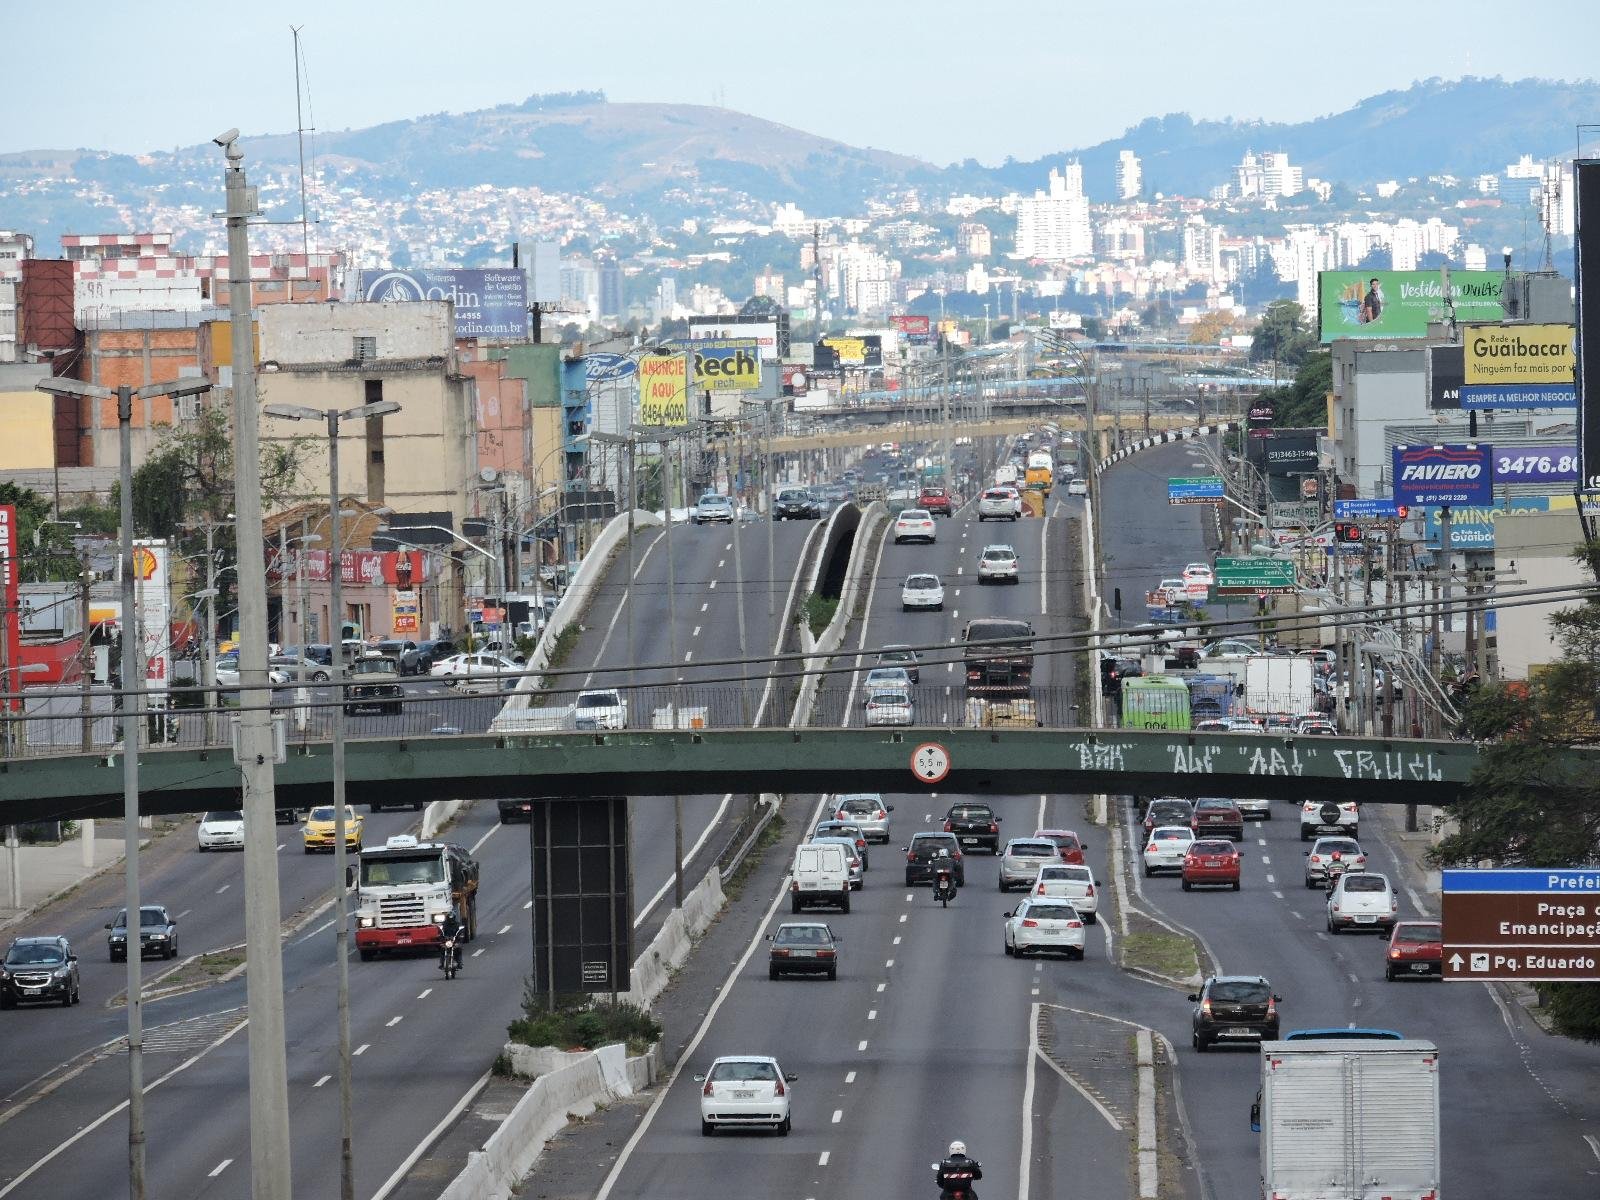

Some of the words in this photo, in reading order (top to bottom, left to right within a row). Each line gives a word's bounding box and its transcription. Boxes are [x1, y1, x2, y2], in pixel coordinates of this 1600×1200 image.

[484, 273, 521, 282] Software
[1490, 335, 1509, 343] Rede
[1473, 337, 1567, 357] Guaibacar
[642, 359, 685, 376] ANUNCIE
[1473, 363, 1512, 375] Ninguém
[1514, 363, 1527, 373] faz
[1530, 363, 1549, 372] mais
[1552, 364, 1566, 373] por
[652, 382, 674, 398] AQUI
[1466, 394, 1497, 403] SEMPRE
[1498, 394, 1506, 402] A
[1507, 393, 1540, 402] MELHOR
[1402, 464, 1482, 481] FAVIERO
[919, 758, 933, 768] 5,5
[1538, 903, 1585, 918] Praça
[1494, 956, 1522, 971] Pq.
[1526, 956, 1595, 969] Eduardo
